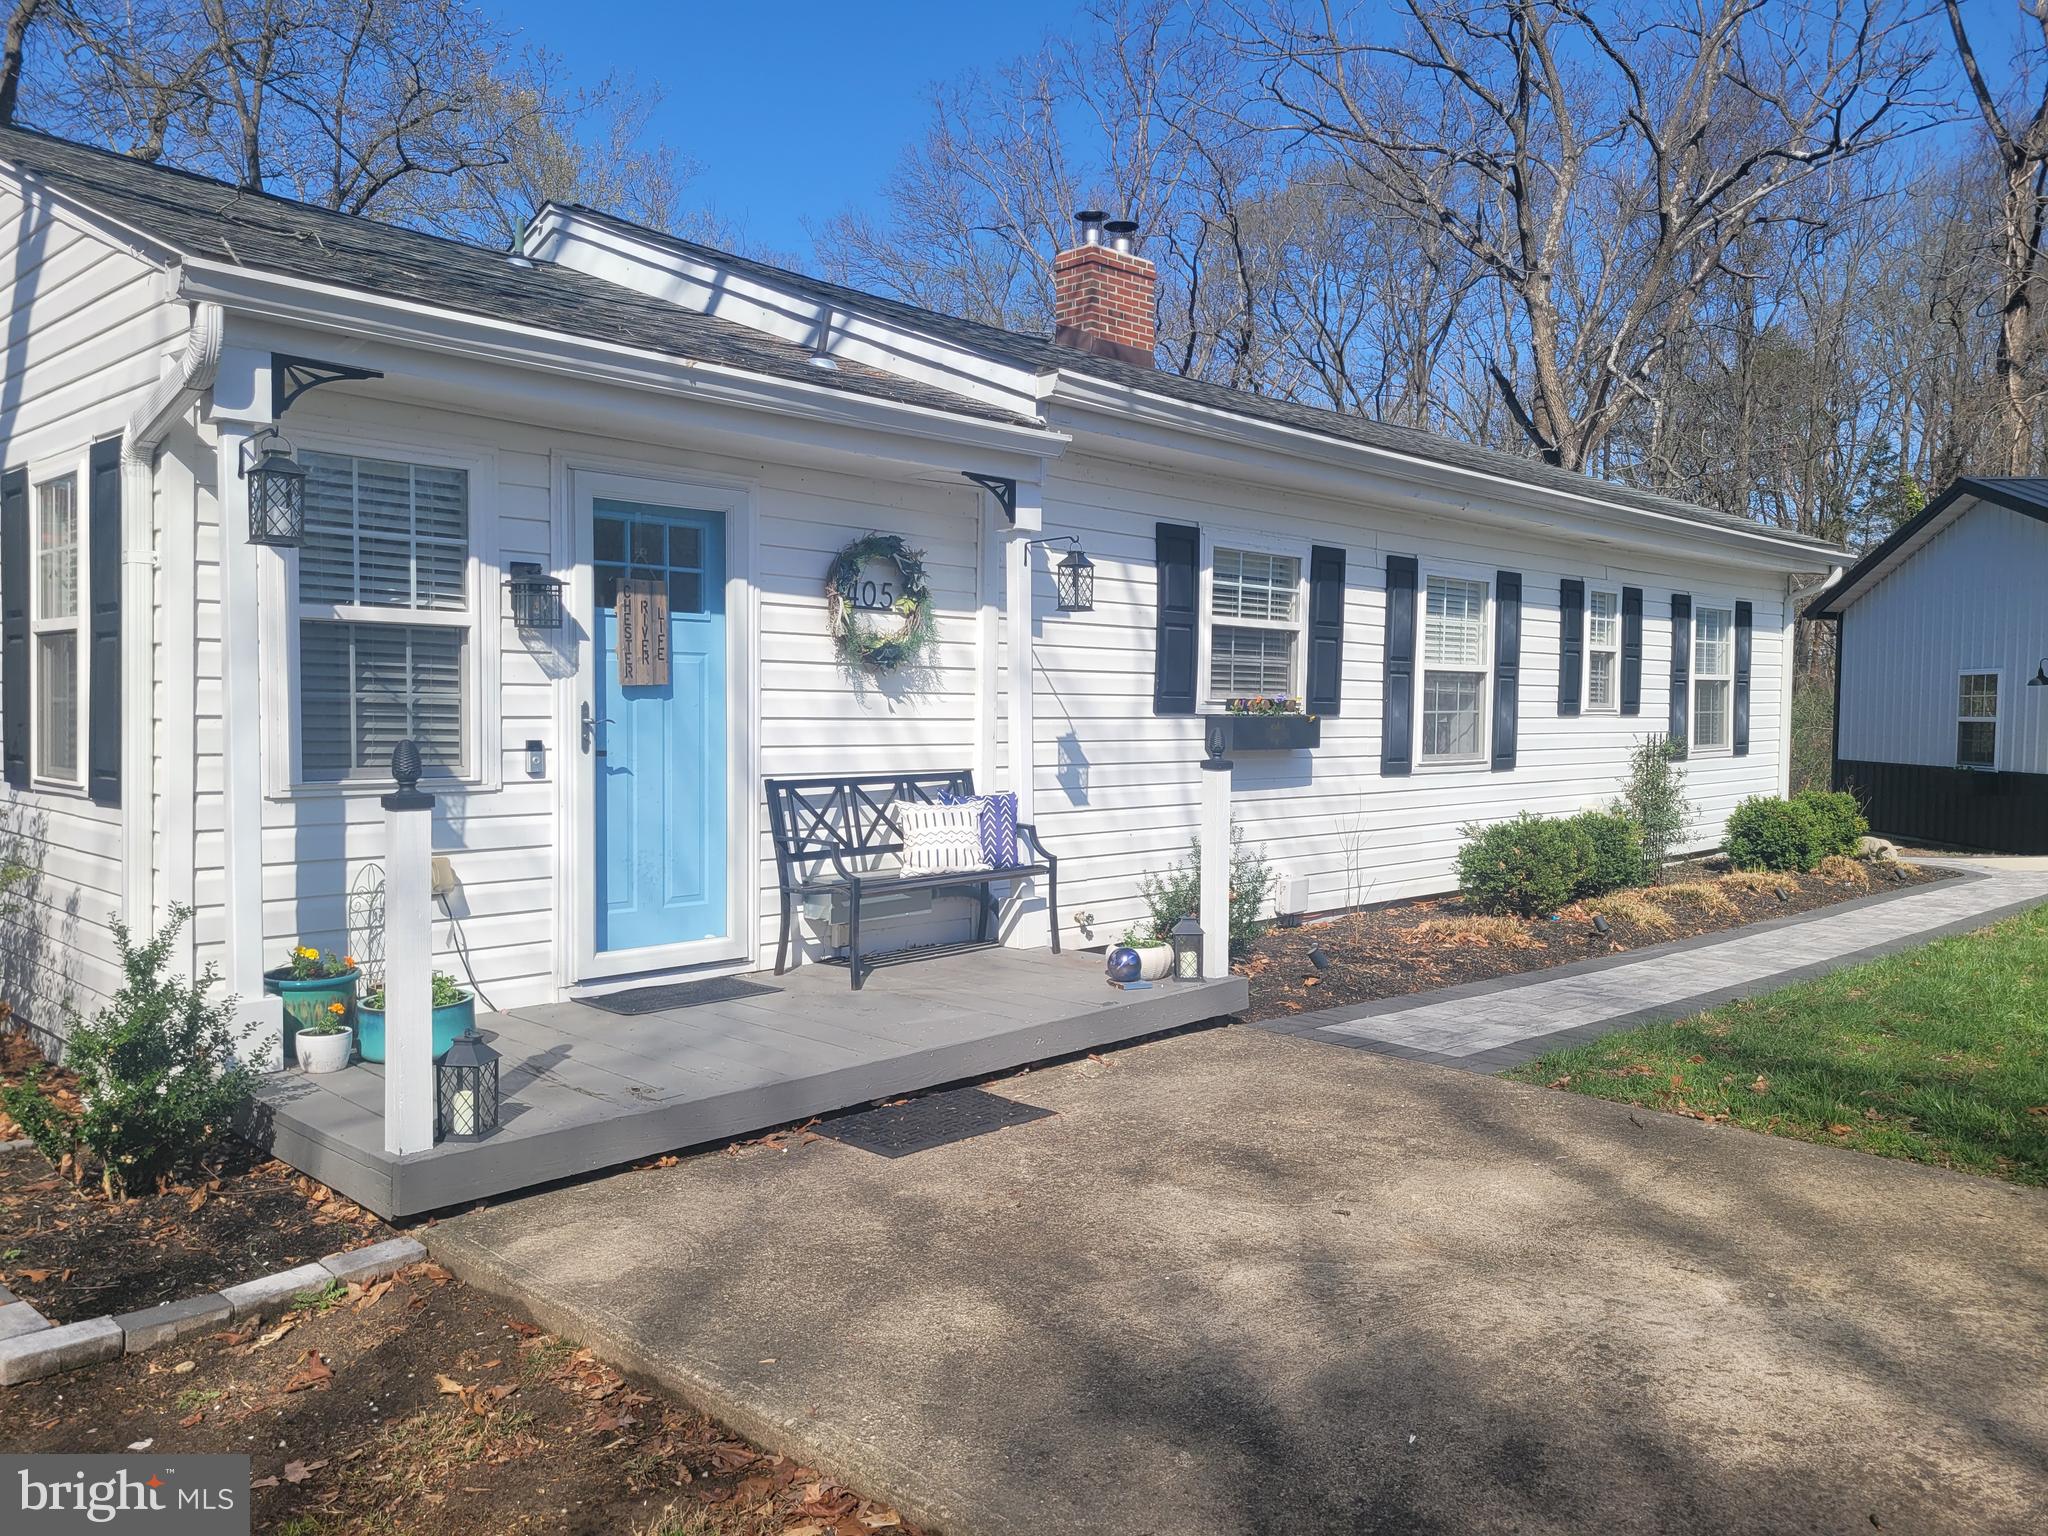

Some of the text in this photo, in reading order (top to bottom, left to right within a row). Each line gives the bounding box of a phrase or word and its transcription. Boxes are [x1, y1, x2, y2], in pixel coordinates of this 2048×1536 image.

[847, 580, 893, 609] 405
[623, 585, 633, 679] CHESTER
[640, 600, 650, 665] RIVER
[657, 607, 665, 661] LIFE
